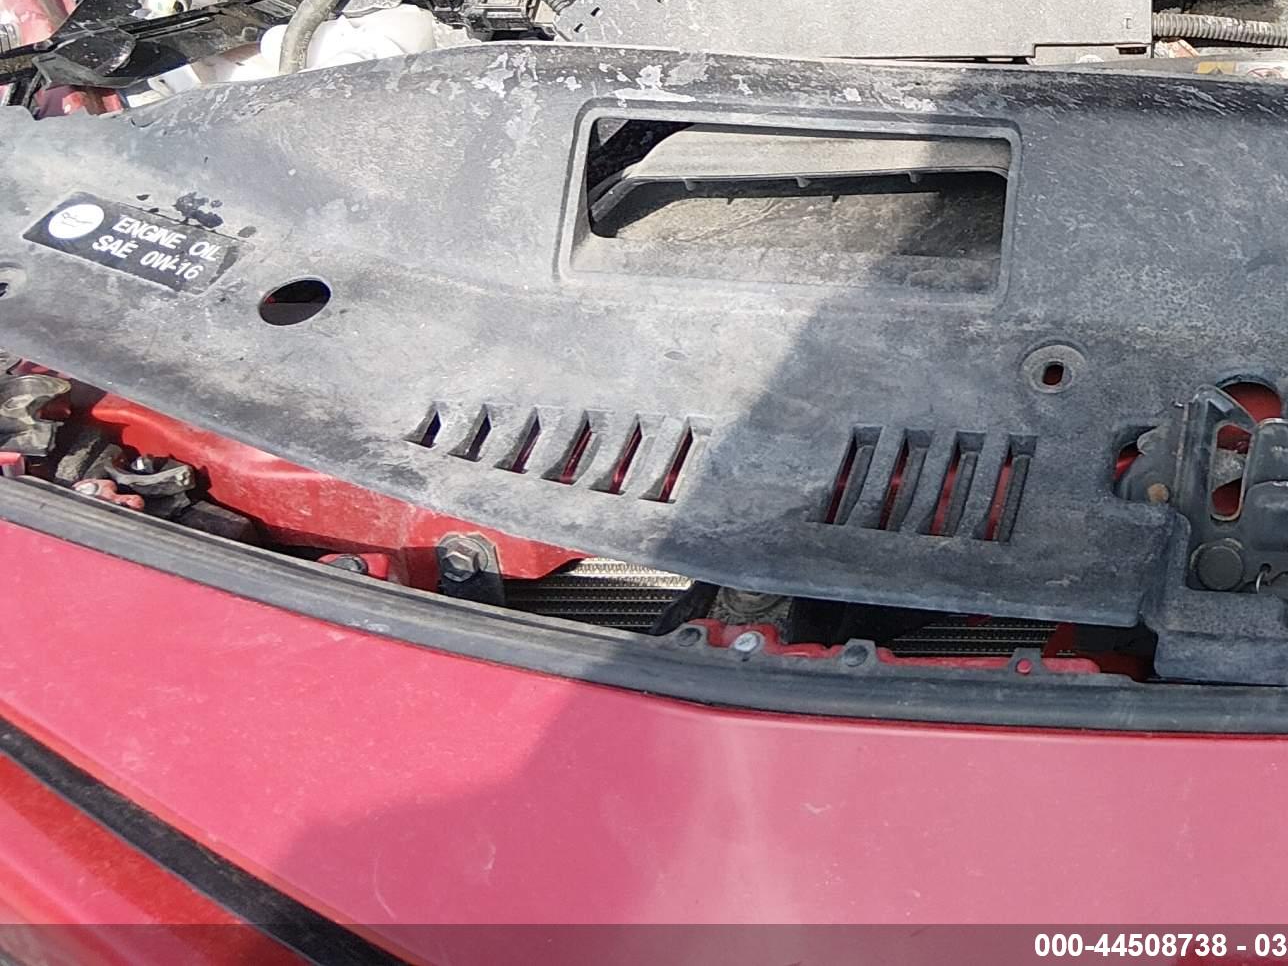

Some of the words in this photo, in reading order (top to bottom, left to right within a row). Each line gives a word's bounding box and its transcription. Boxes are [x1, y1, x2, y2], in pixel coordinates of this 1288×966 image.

[92, 235, 139, 259] SAE
[140, 250, 204, 280] 0W-16
[112, 214, 187, 250] ENGINE
[189, 241, 222, 262] OIL
